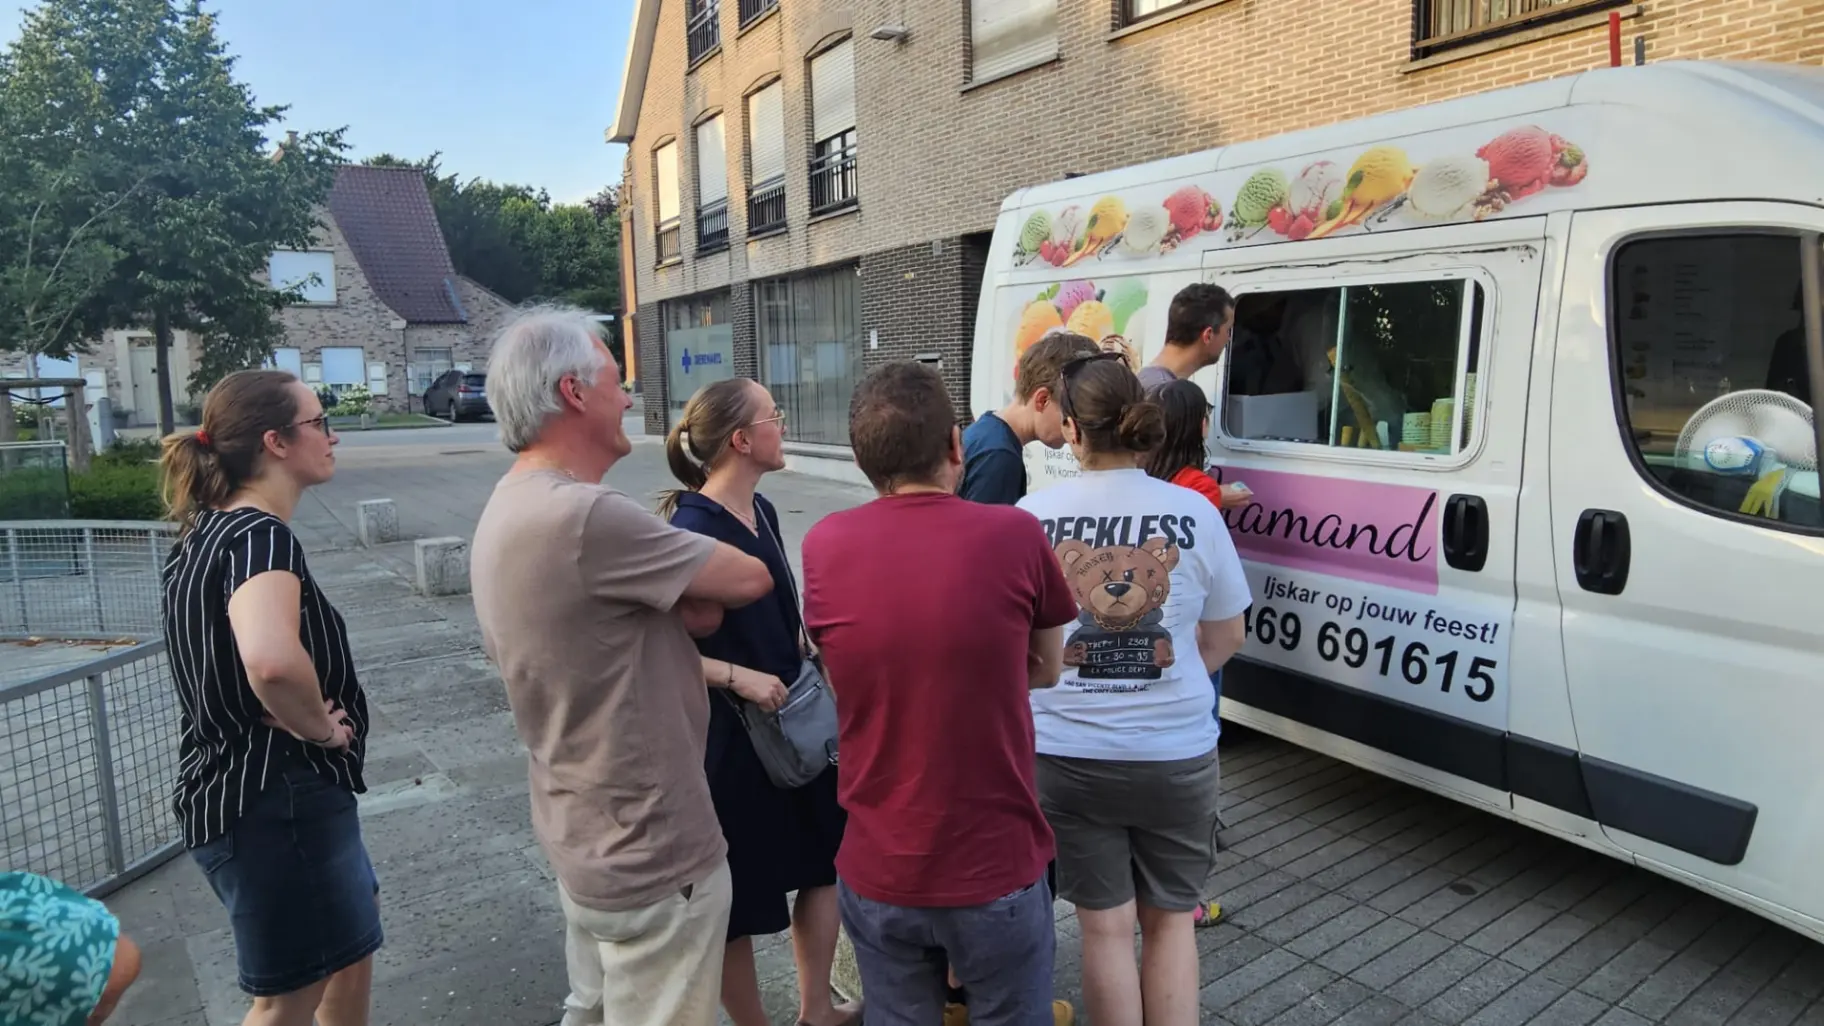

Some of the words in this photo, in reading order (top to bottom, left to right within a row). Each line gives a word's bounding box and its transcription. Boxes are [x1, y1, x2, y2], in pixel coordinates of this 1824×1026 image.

[1222, 490, 1437, 562] iamand
[1264, 576, 1320, 604] Ijskar
[1326, 592, 1352, 615] op
[1356, 596, 1416, 626] jouw
[1423, 609, 1500, 644] feest!
[1317, 621, 1497, 702] 691615
